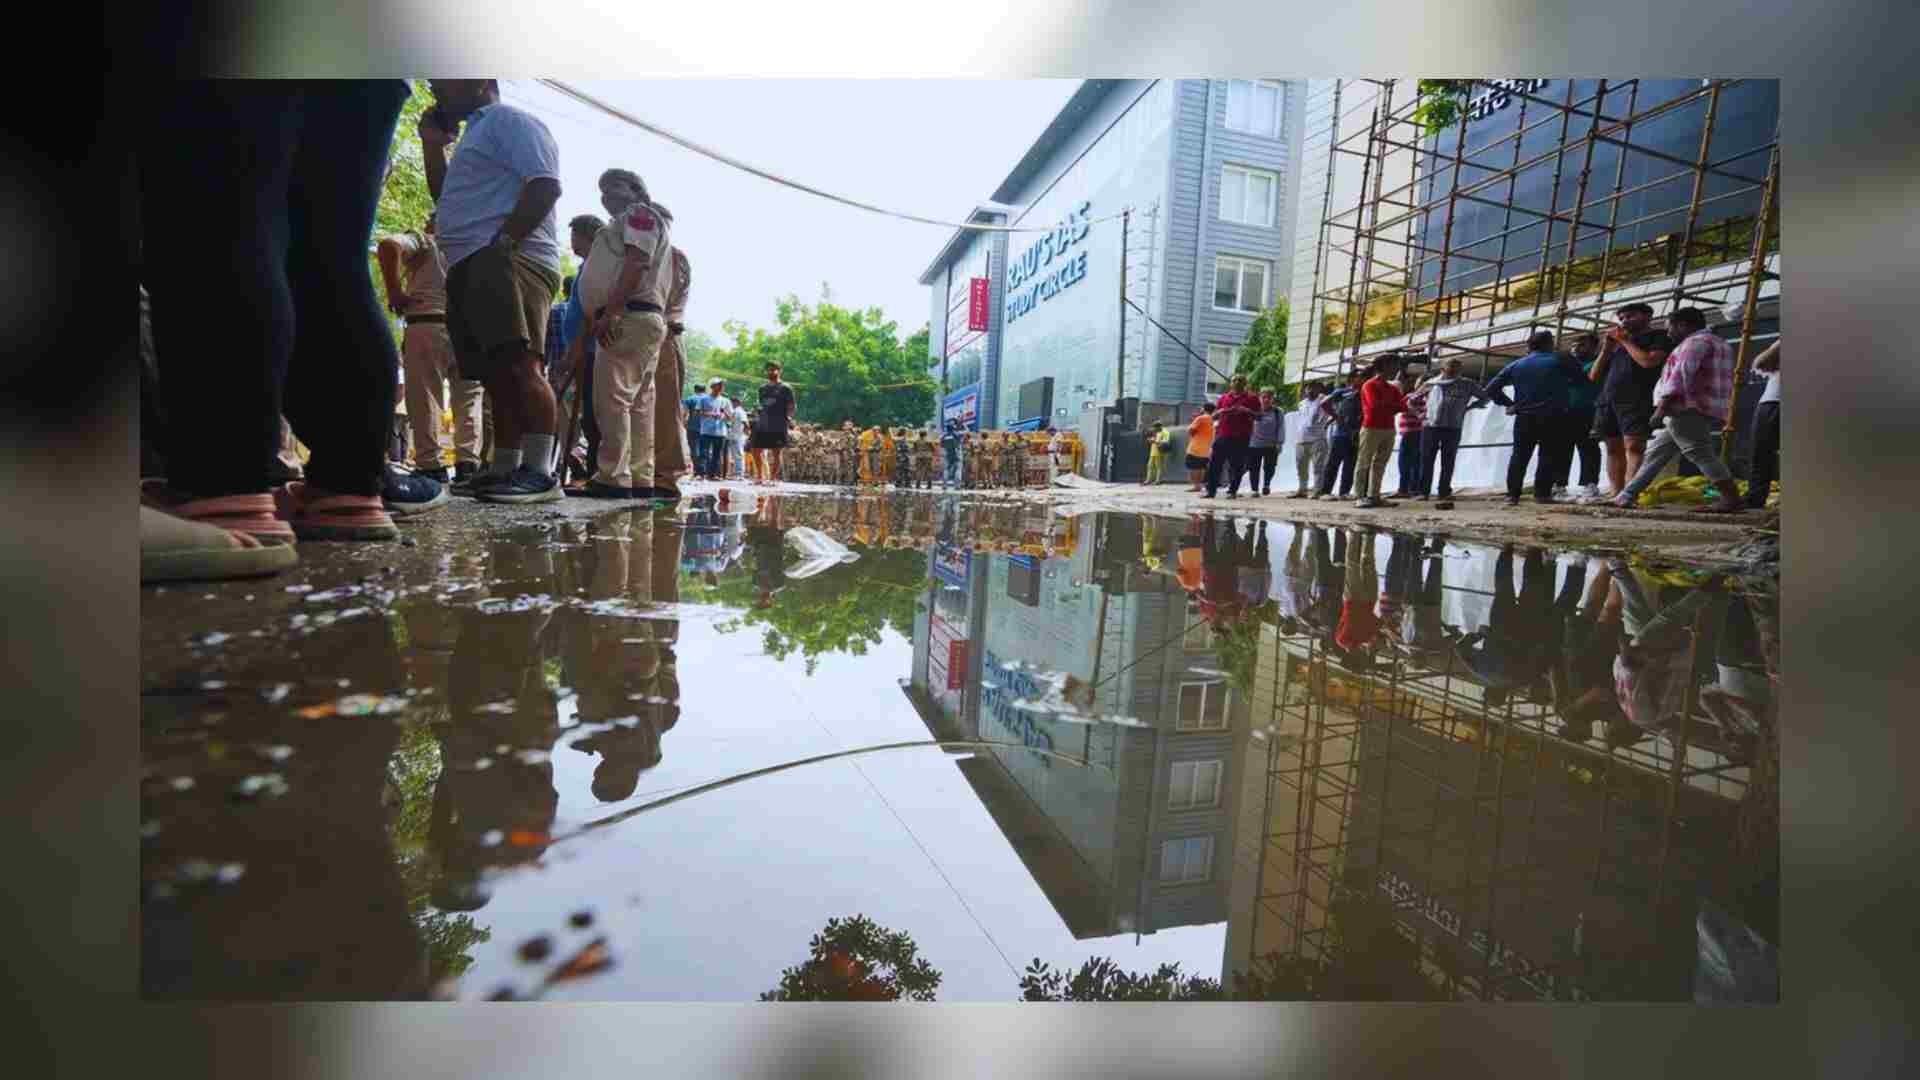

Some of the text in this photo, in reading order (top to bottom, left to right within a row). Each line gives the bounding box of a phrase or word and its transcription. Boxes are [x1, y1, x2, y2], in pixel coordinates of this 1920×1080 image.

[1007, 201, 1090, 292] RAU'S IAS
[1007, 284, 1040, 323] STUDY
[1041, 251, 1088, 301] CIRCLE
